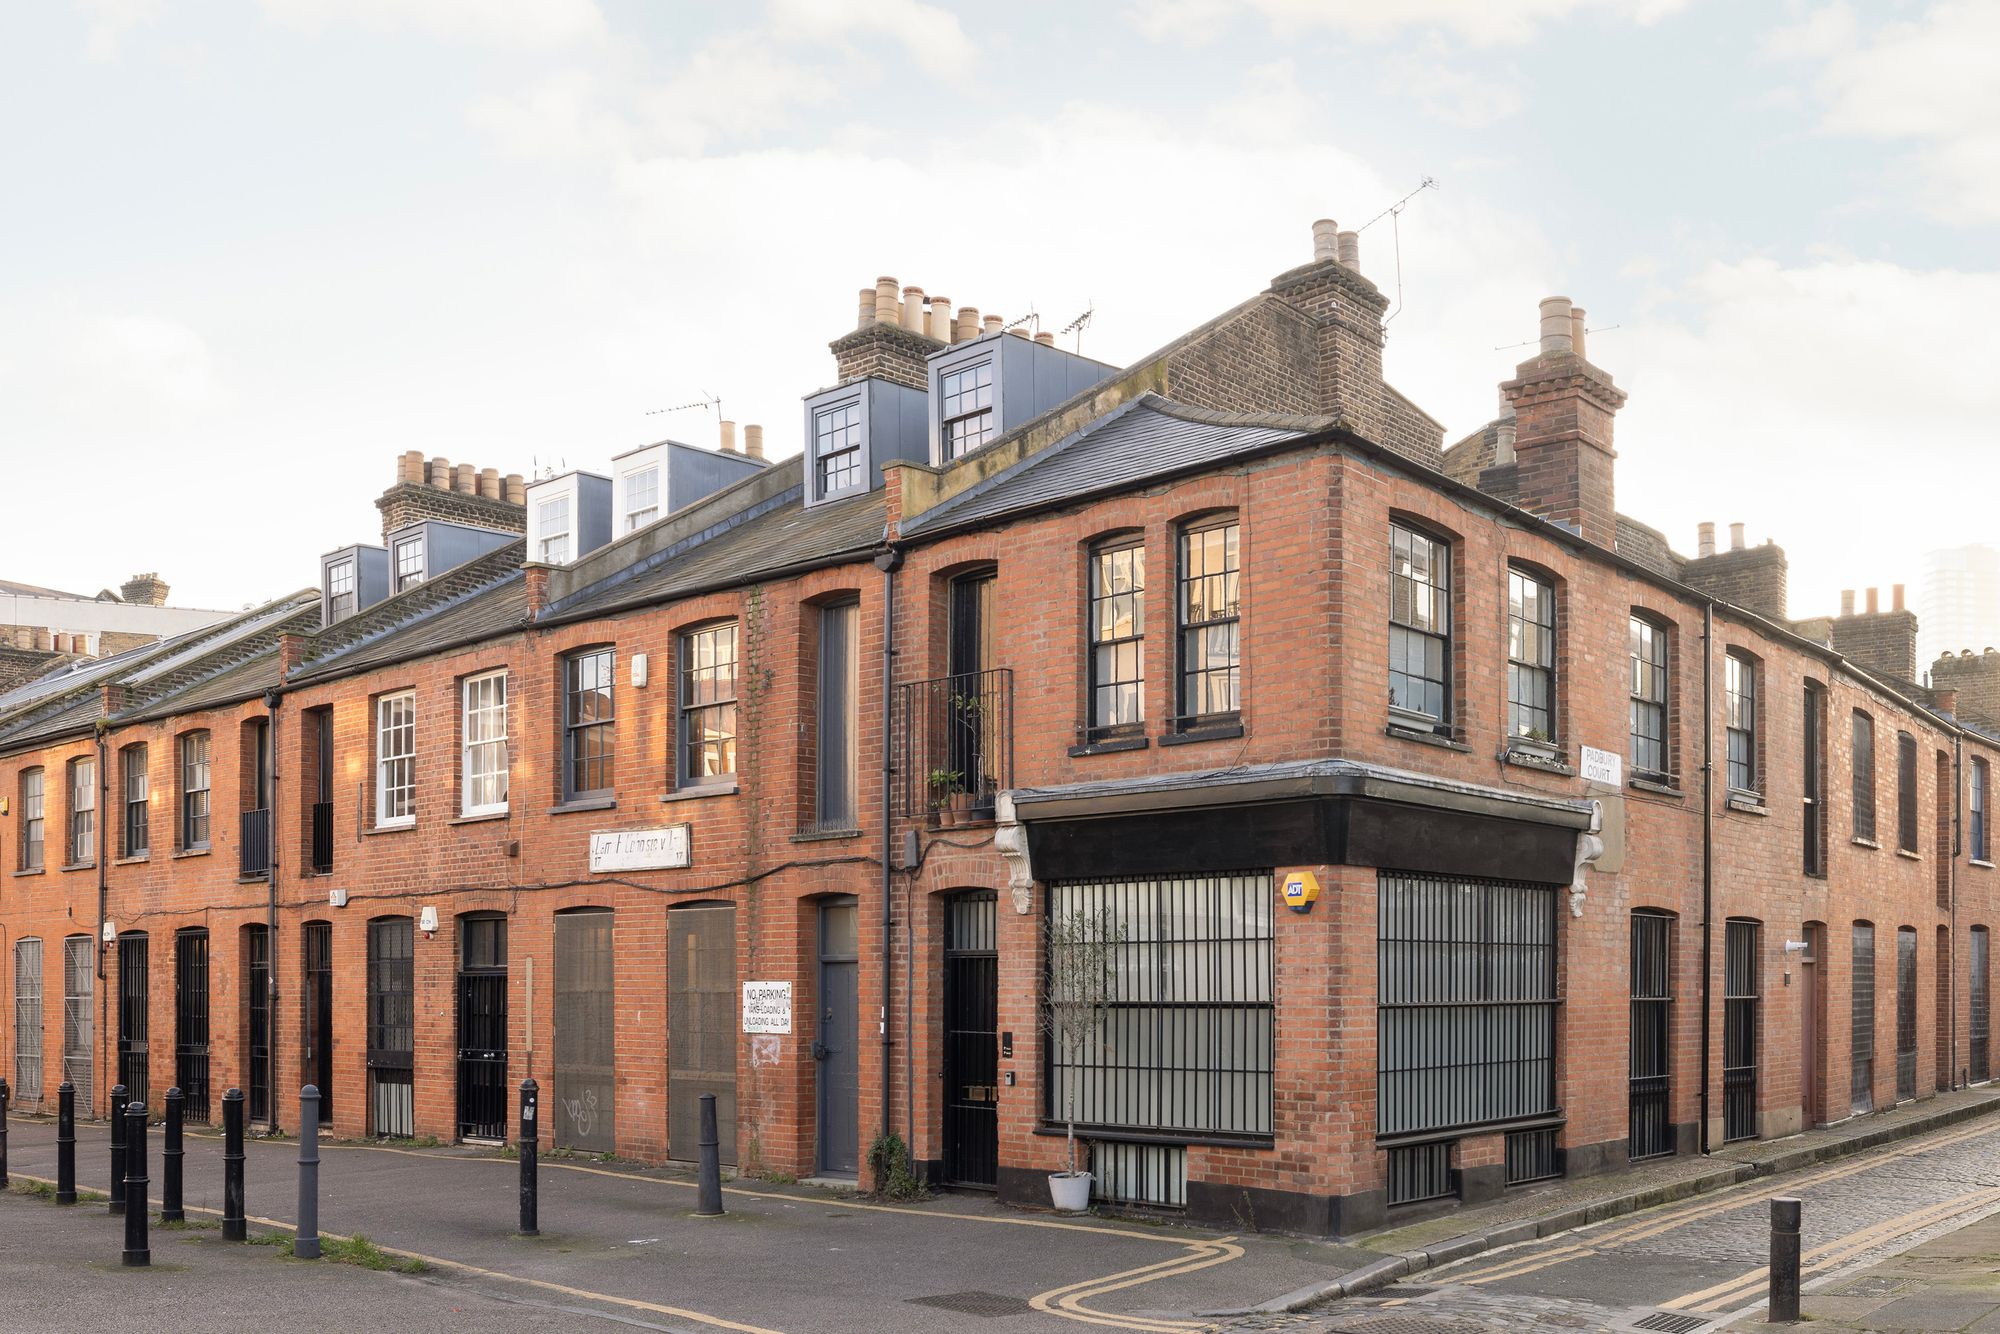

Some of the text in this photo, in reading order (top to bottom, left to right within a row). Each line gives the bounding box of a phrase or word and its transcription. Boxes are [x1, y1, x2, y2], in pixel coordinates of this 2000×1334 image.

[1587, 749, 1616, 767] PADBURY
[1588, 765, 1610, 781] COURT
[1288, 884, 1302, 895] ADT
[747, 989, 786, 1000] NO PARKING
[771, 1018, 779, 1026] ALL
